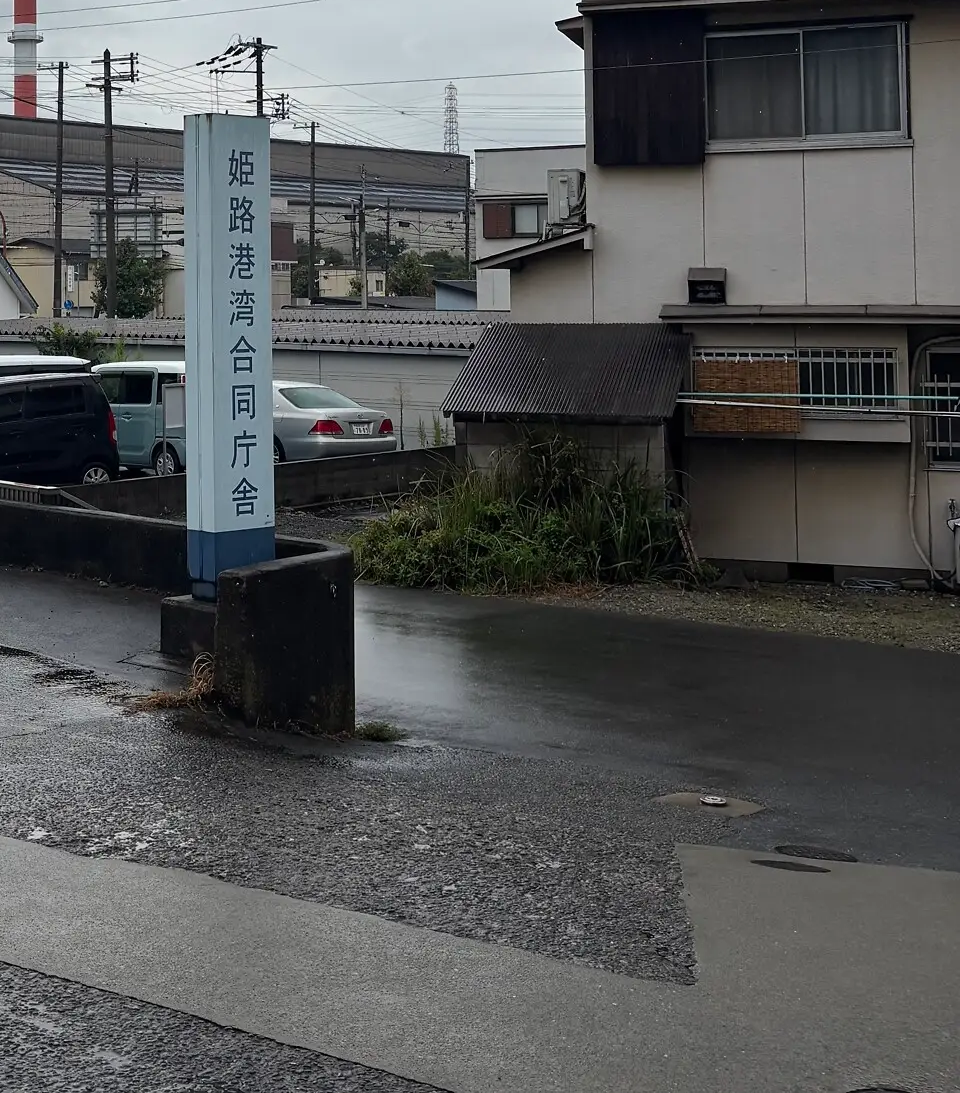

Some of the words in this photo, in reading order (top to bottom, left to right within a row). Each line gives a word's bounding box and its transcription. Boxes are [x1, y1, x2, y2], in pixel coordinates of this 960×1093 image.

[228, 148, 259, 517] 姫路港湾合同庁舎
